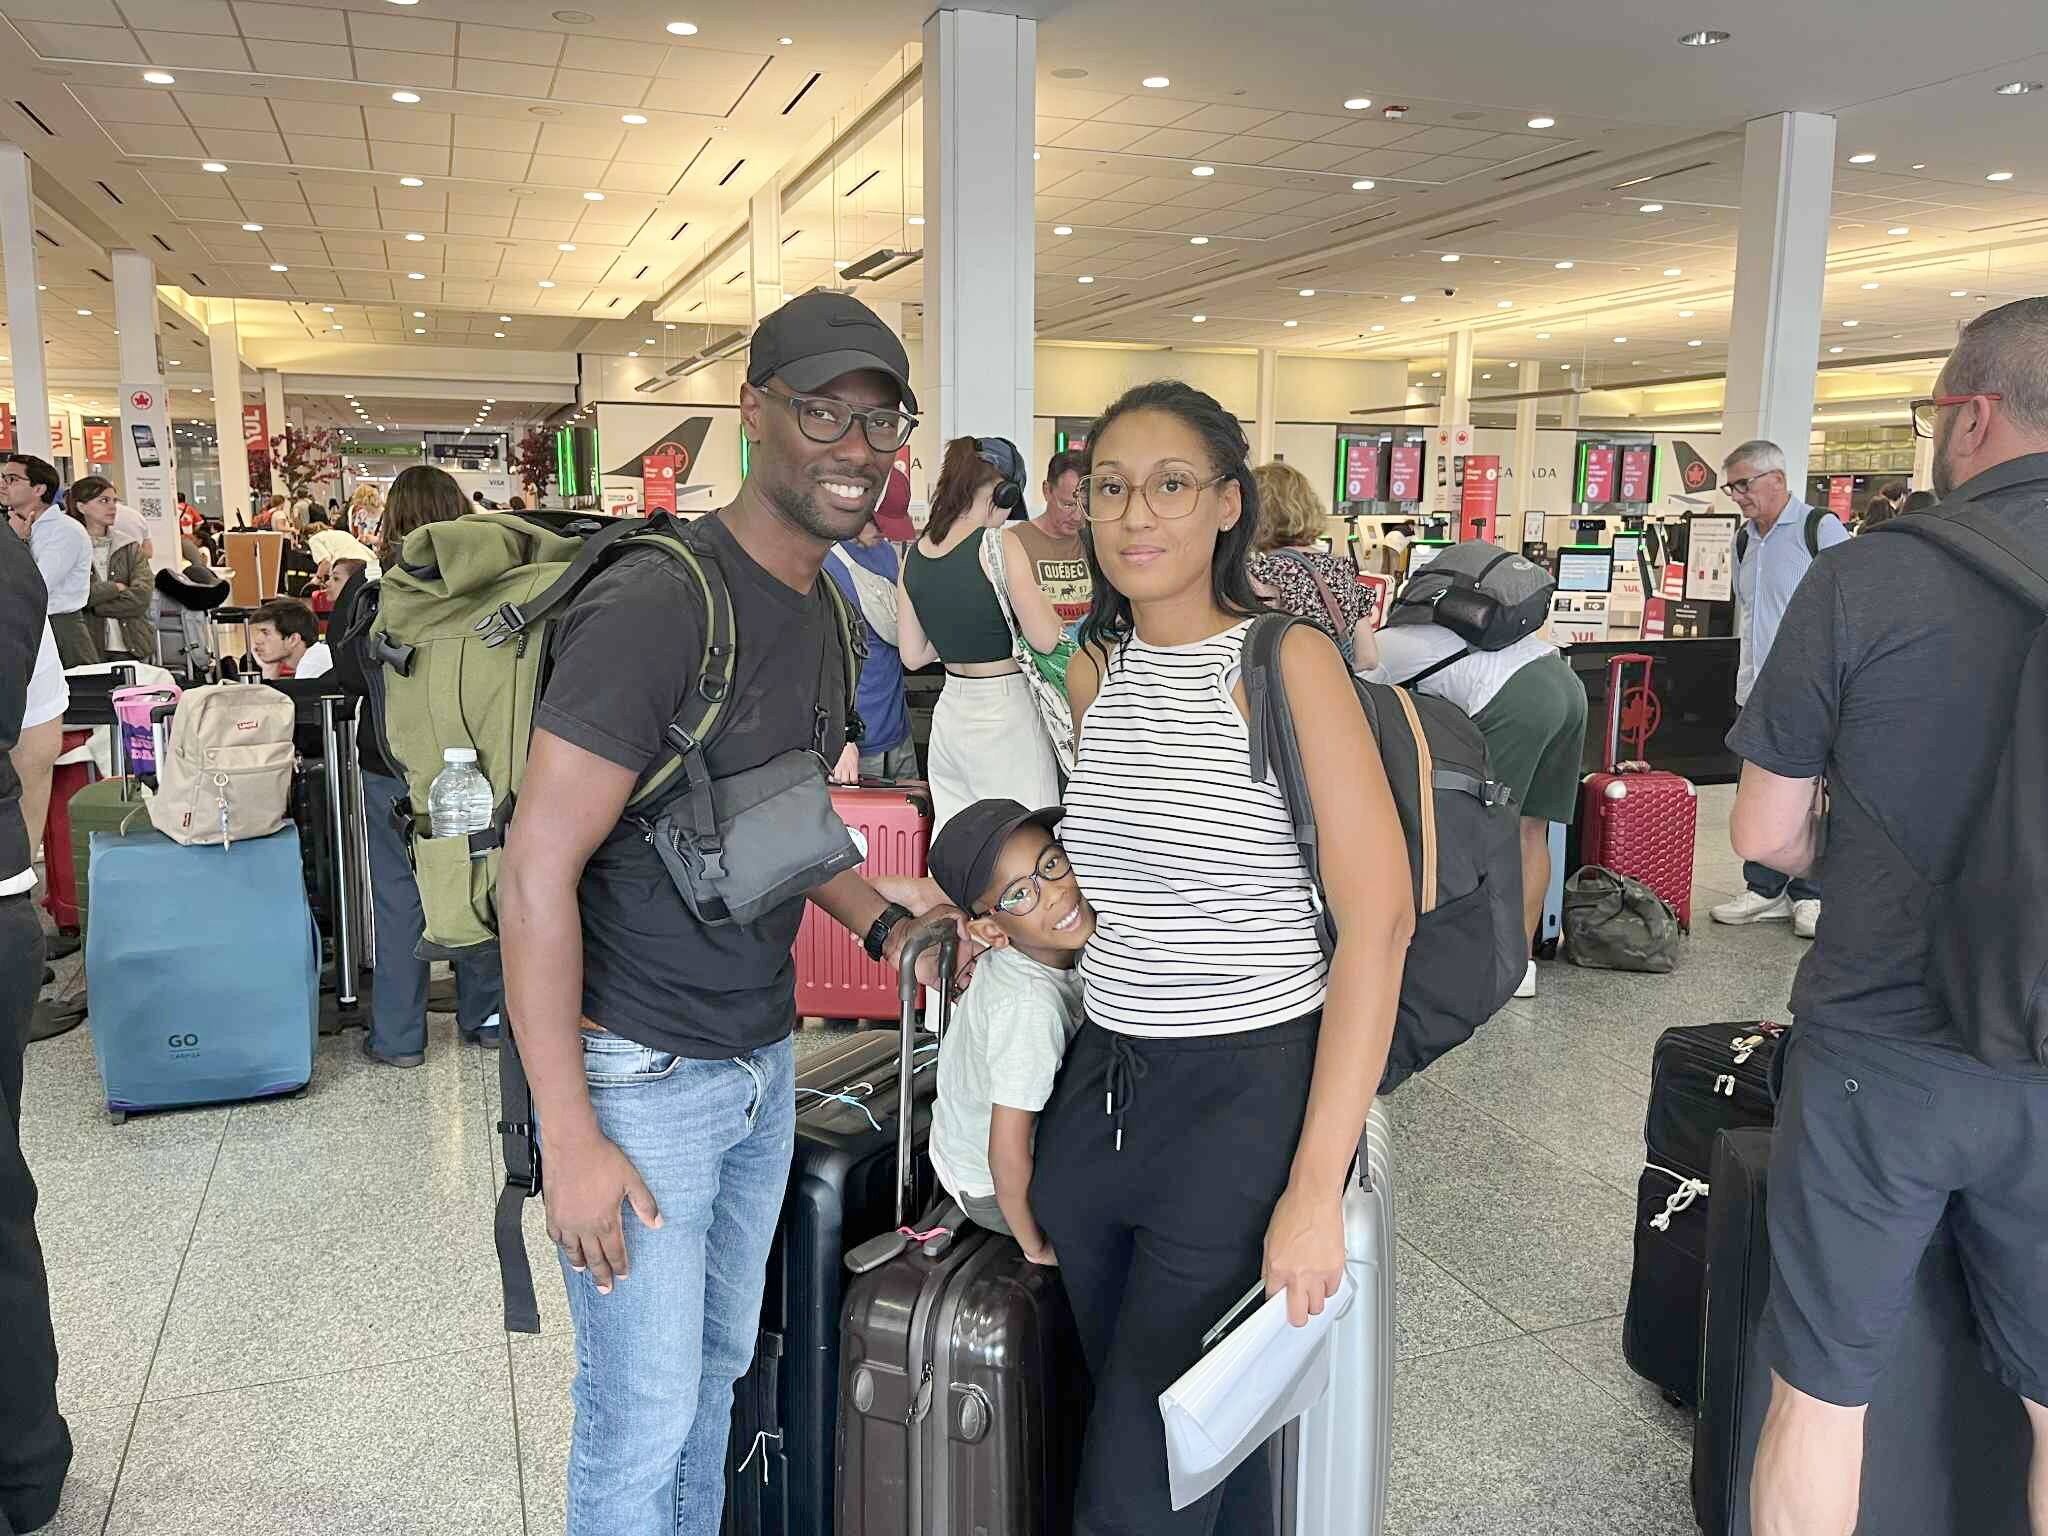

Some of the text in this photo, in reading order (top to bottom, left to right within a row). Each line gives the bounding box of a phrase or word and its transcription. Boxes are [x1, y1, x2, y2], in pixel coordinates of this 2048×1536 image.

[244, 410, 262, 443] YUL
[92, 431, 107, 459] YUL
[1044, 562, 1084, 579] QUÉBEC
[168, 1033, 198, 1047] GO
